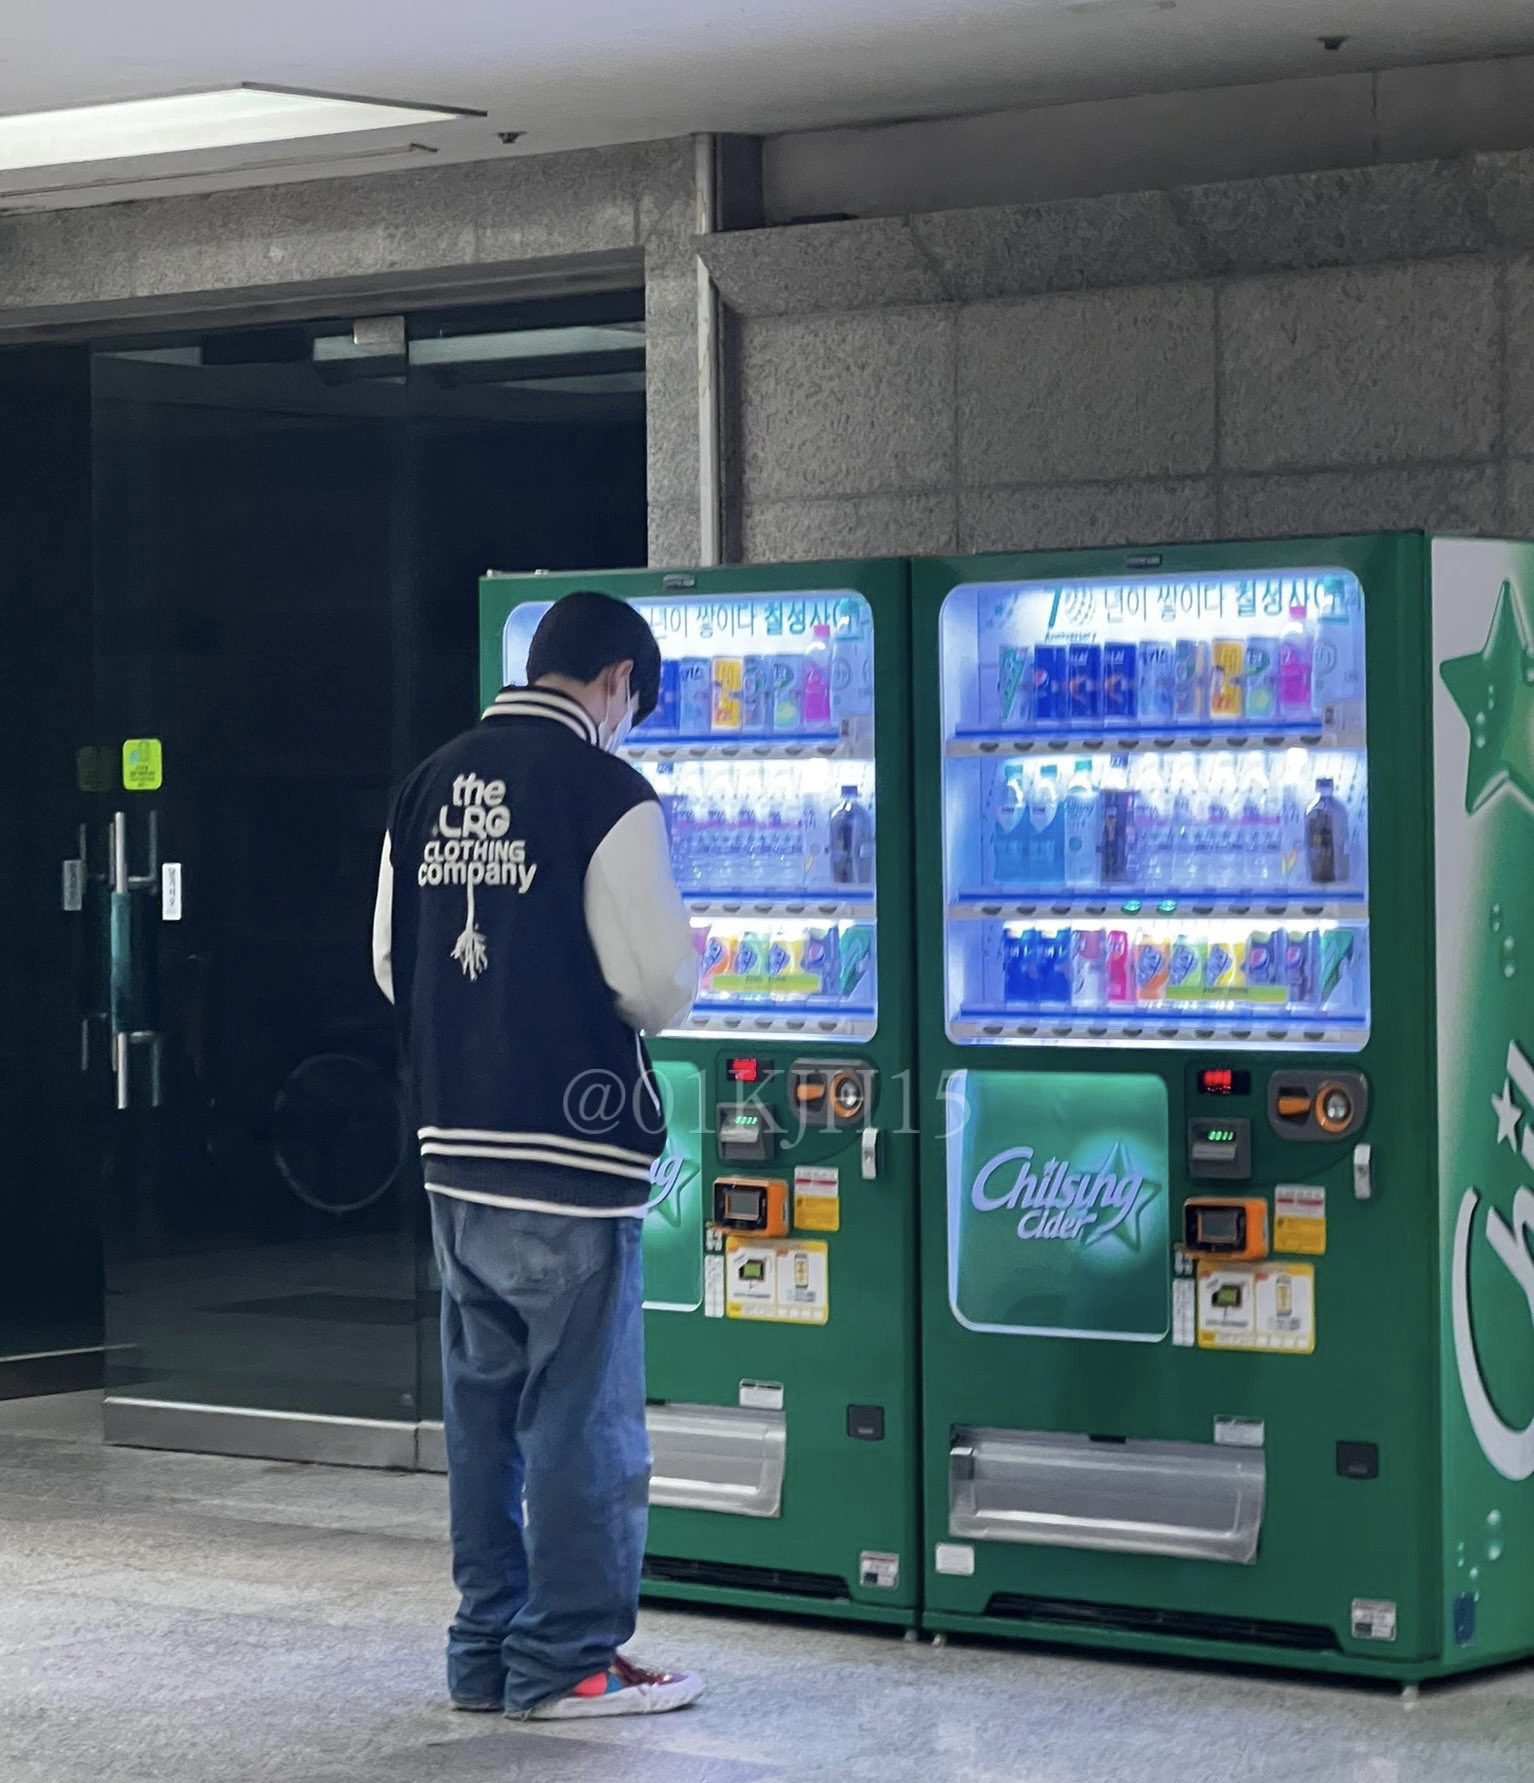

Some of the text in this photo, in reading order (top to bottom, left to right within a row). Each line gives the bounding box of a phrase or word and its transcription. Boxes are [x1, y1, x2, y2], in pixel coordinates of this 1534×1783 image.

[452, 773, 506, 807] the
[439, 805, 511, 839] LRG
[424, 840, 526, 863] CLOTHING
[418, 861, 537, 894] company
[1017, 1208, 1097, 1240] Cider
